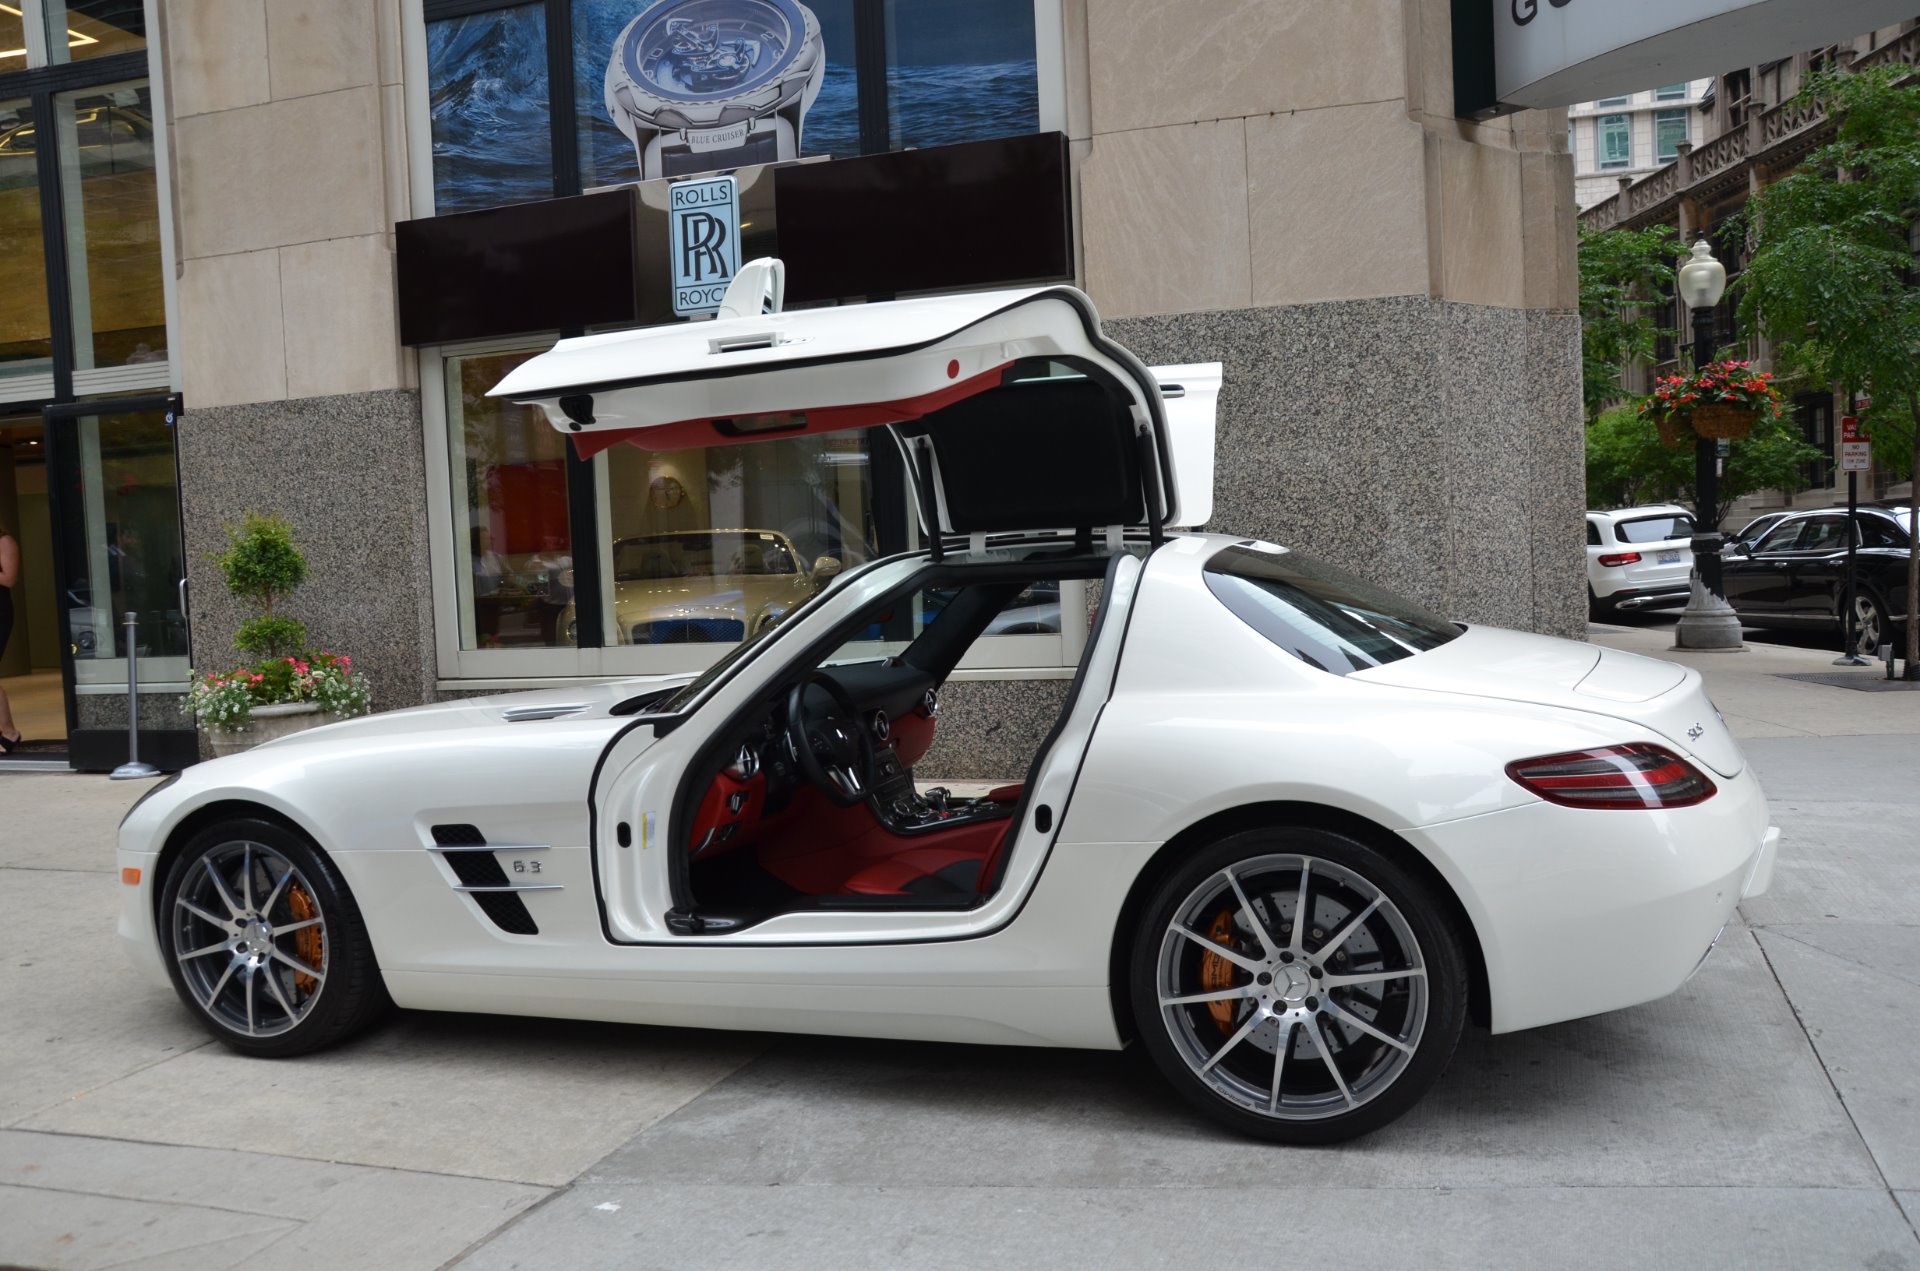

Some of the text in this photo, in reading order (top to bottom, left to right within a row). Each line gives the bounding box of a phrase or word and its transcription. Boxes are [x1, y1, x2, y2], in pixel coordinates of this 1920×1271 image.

[691, 128, 745, 144] BLUE CRUISER
[675, 185, 728, 206] ROLLS
[680, 211, 729, 282] RR
